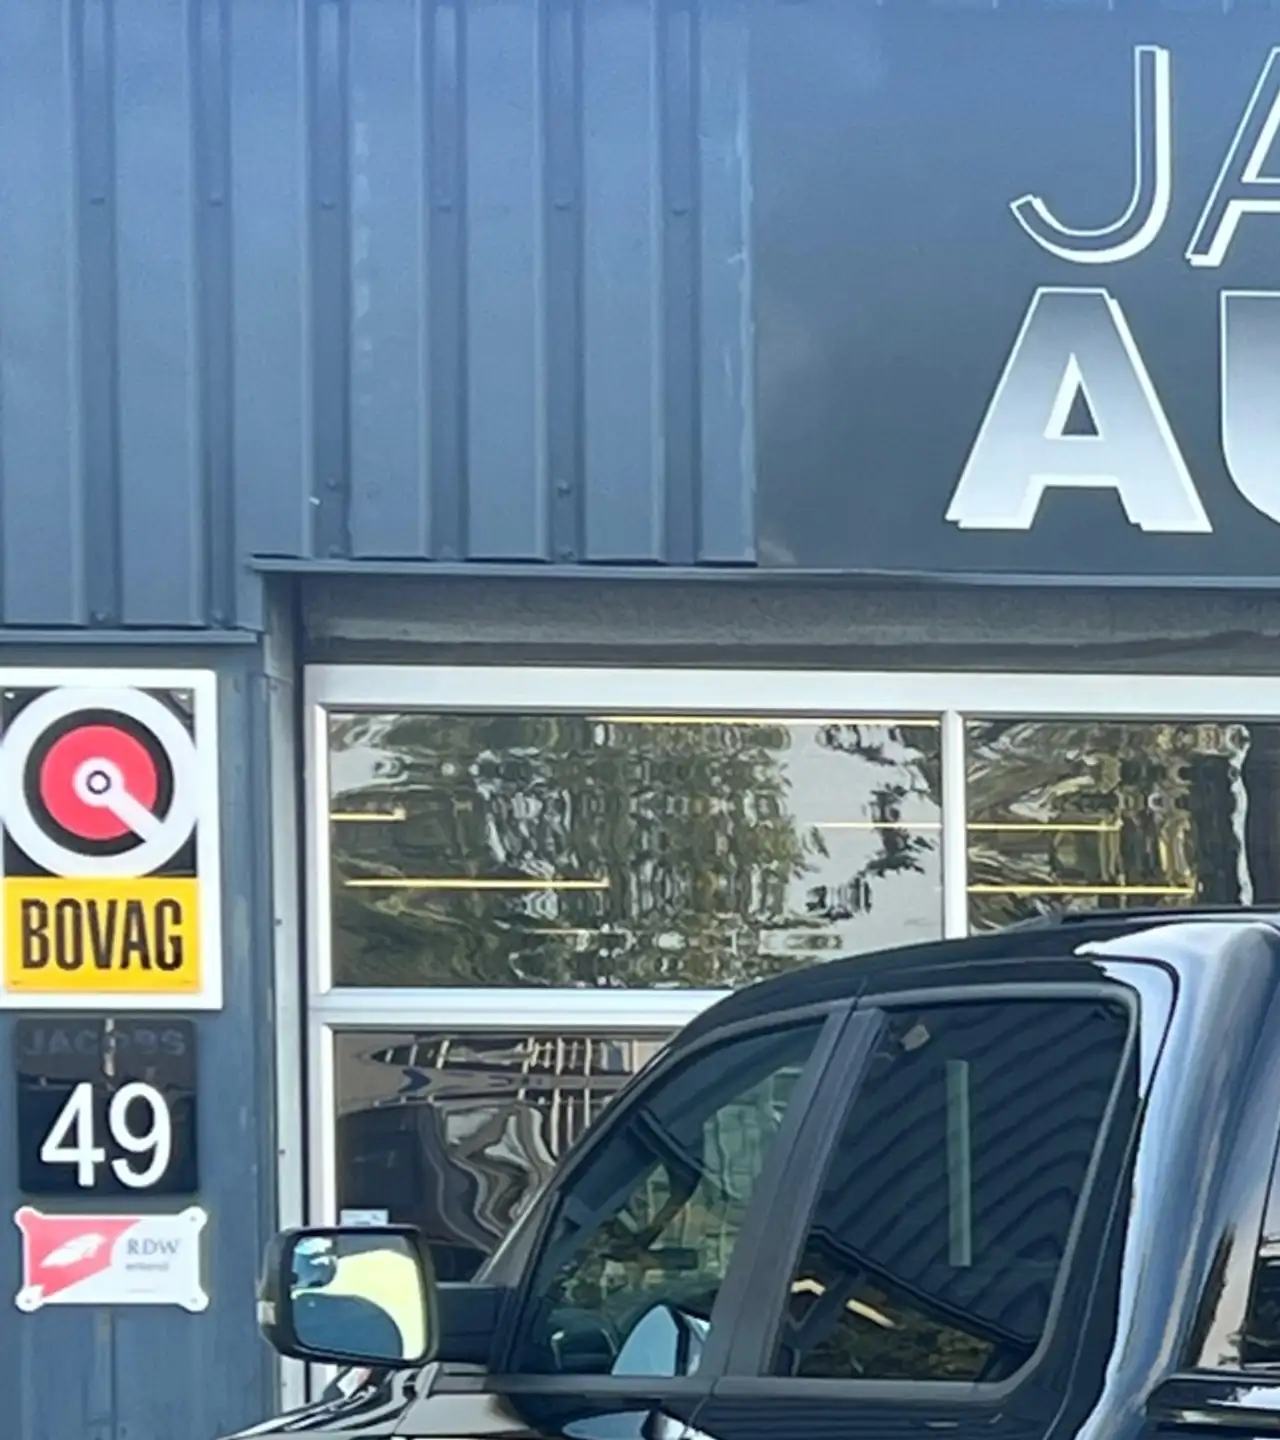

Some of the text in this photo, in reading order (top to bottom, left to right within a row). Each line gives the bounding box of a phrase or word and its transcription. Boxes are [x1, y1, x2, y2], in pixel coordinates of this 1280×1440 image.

[20, 897, 184, 972] BOVAG
[40, 1081, 172, 1188] 49
[126, 1237, 181, 1255] RDW
